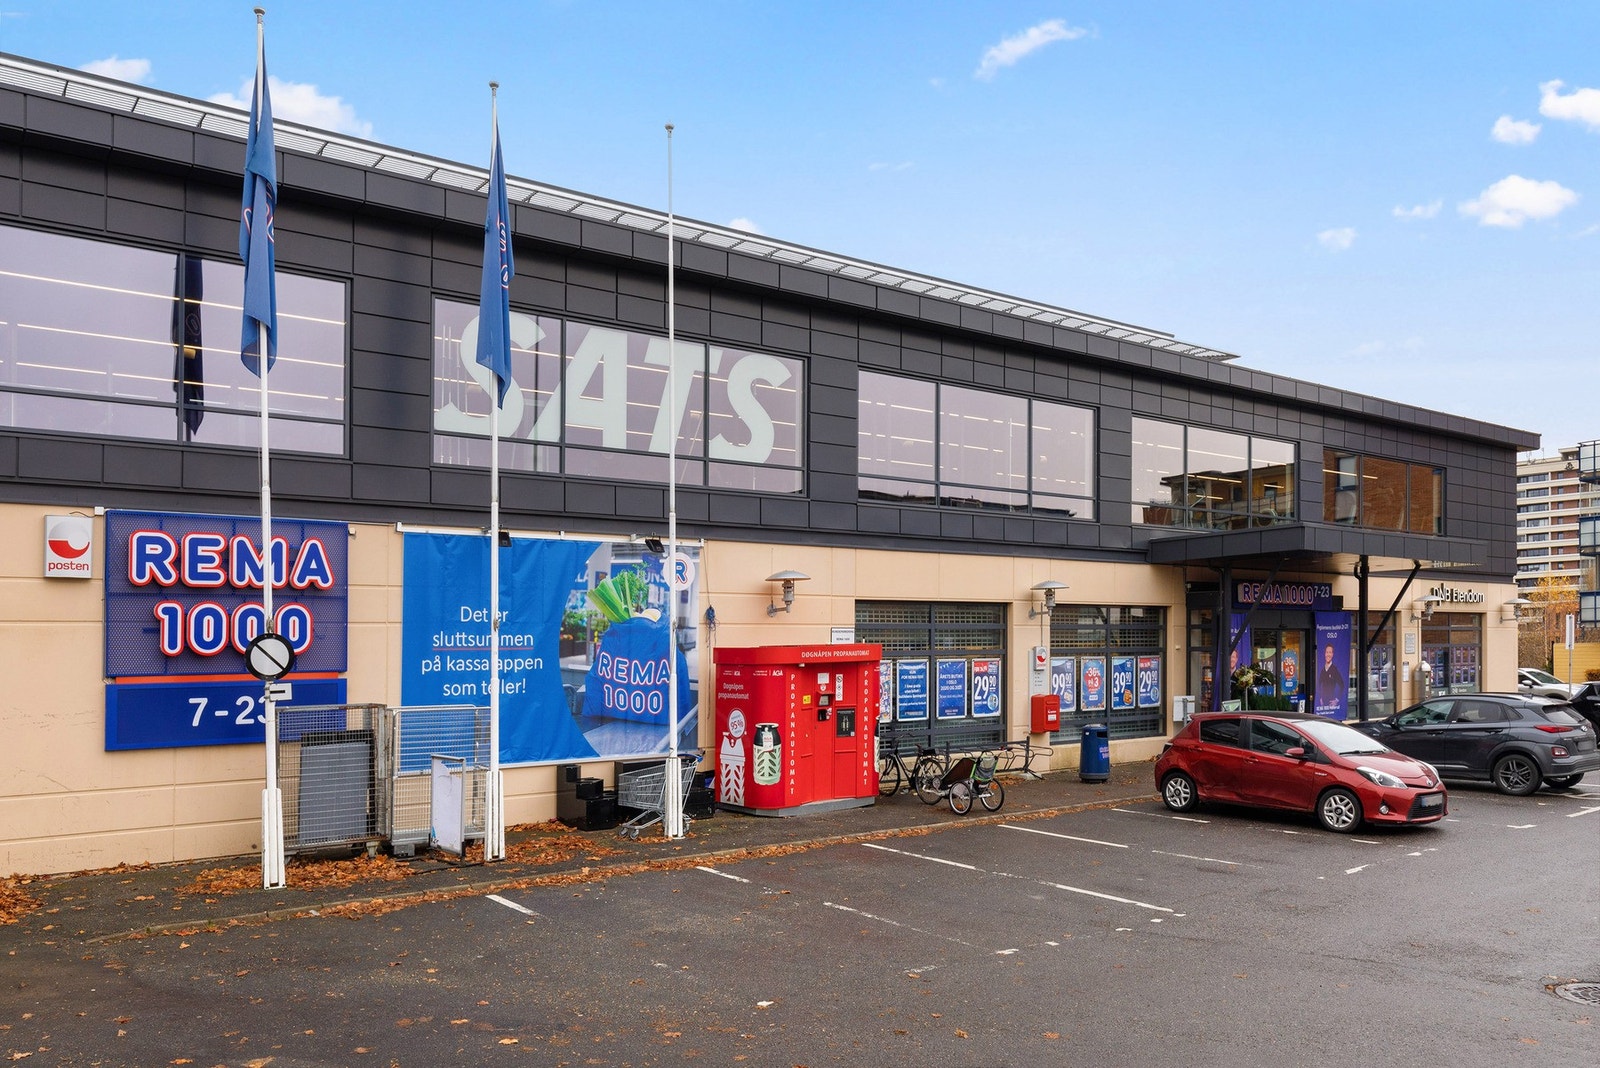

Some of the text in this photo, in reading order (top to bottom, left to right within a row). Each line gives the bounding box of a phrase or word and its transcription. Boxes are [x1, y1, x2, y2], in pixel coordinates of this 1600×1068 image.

[434, 312, 792, 463] SATS
[48, 560, 89, 572] posten
[128, 529, 334, 590] REMA
[1242, 582, 1330, 604] REMA 1000 7-23
[1453, 588, 1485, 603] Eiendom
[460, 606, 488, 622] Det
[154, 600, 314, 657] 1000
[801, 649, 870, 658] DØGNÅPEN PROPANAUTOMAT
[421, 655, 543, 675] på kassaappen
[598, 652, 672, 686] REMA
[443, 683, 477, 697] som
[974, 675, 989, 700] 29
[1052, 673, 1066, 695] 99
[1113, 672, 1126, 694] 39
[1140, 671, 1152, 692] 29
[604, 684, 663, 715] 1000
